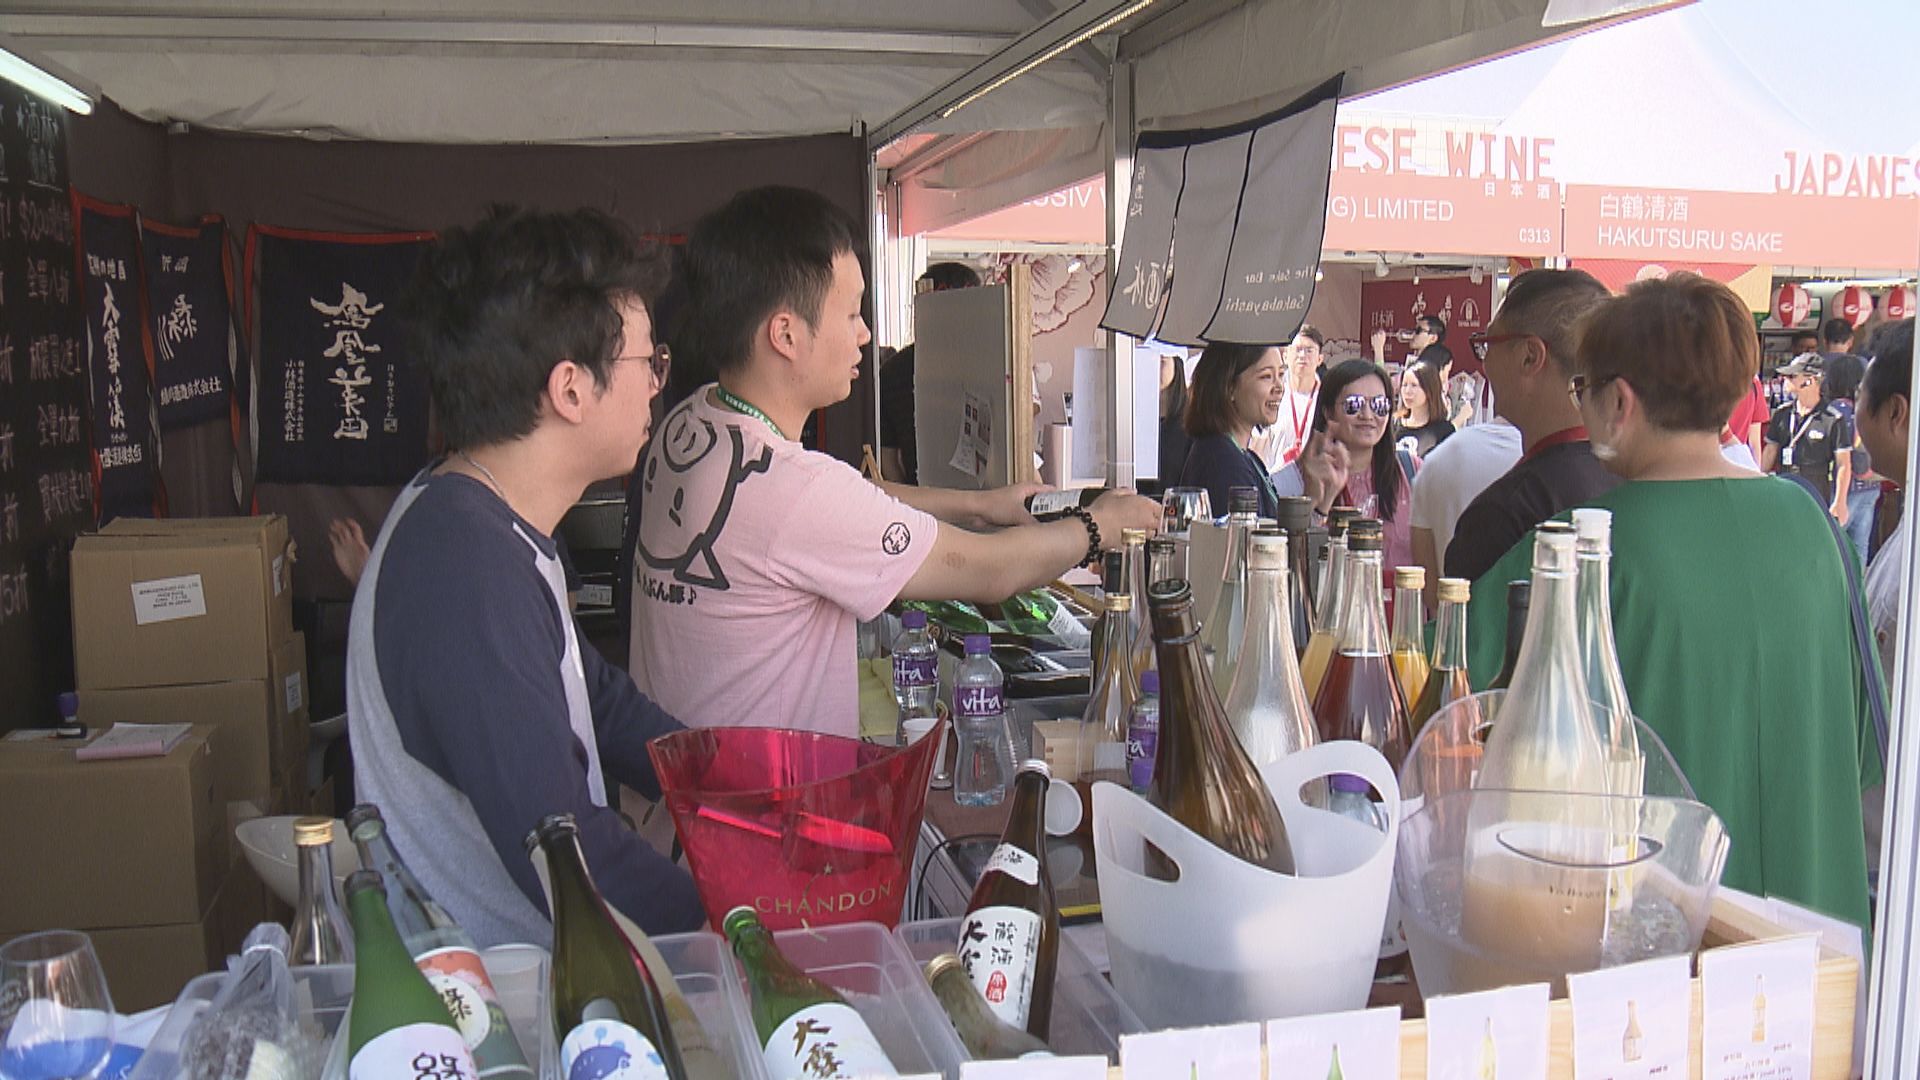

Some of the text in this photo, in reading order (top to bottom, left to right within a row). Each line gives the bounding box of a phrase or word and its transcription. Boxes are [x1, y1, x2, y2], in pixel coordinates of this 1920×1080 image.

[1445, 130, 1555, 182] WINE
[1775, 150, 1920, 198] JAPANE
[1484, 182, 1550, 200] 日本酒
[1364, 197, 1454, 221] LIMITED
[1601, 195, 1689, 222] 白鶴清酒
[1519, 227, 1551, 244] C313
[1599, 225, 1783, 252] HAKUTSURU SAKE
[962, 687, 1001, 711] vita
[755, 879, 893, 916] CHANDON
